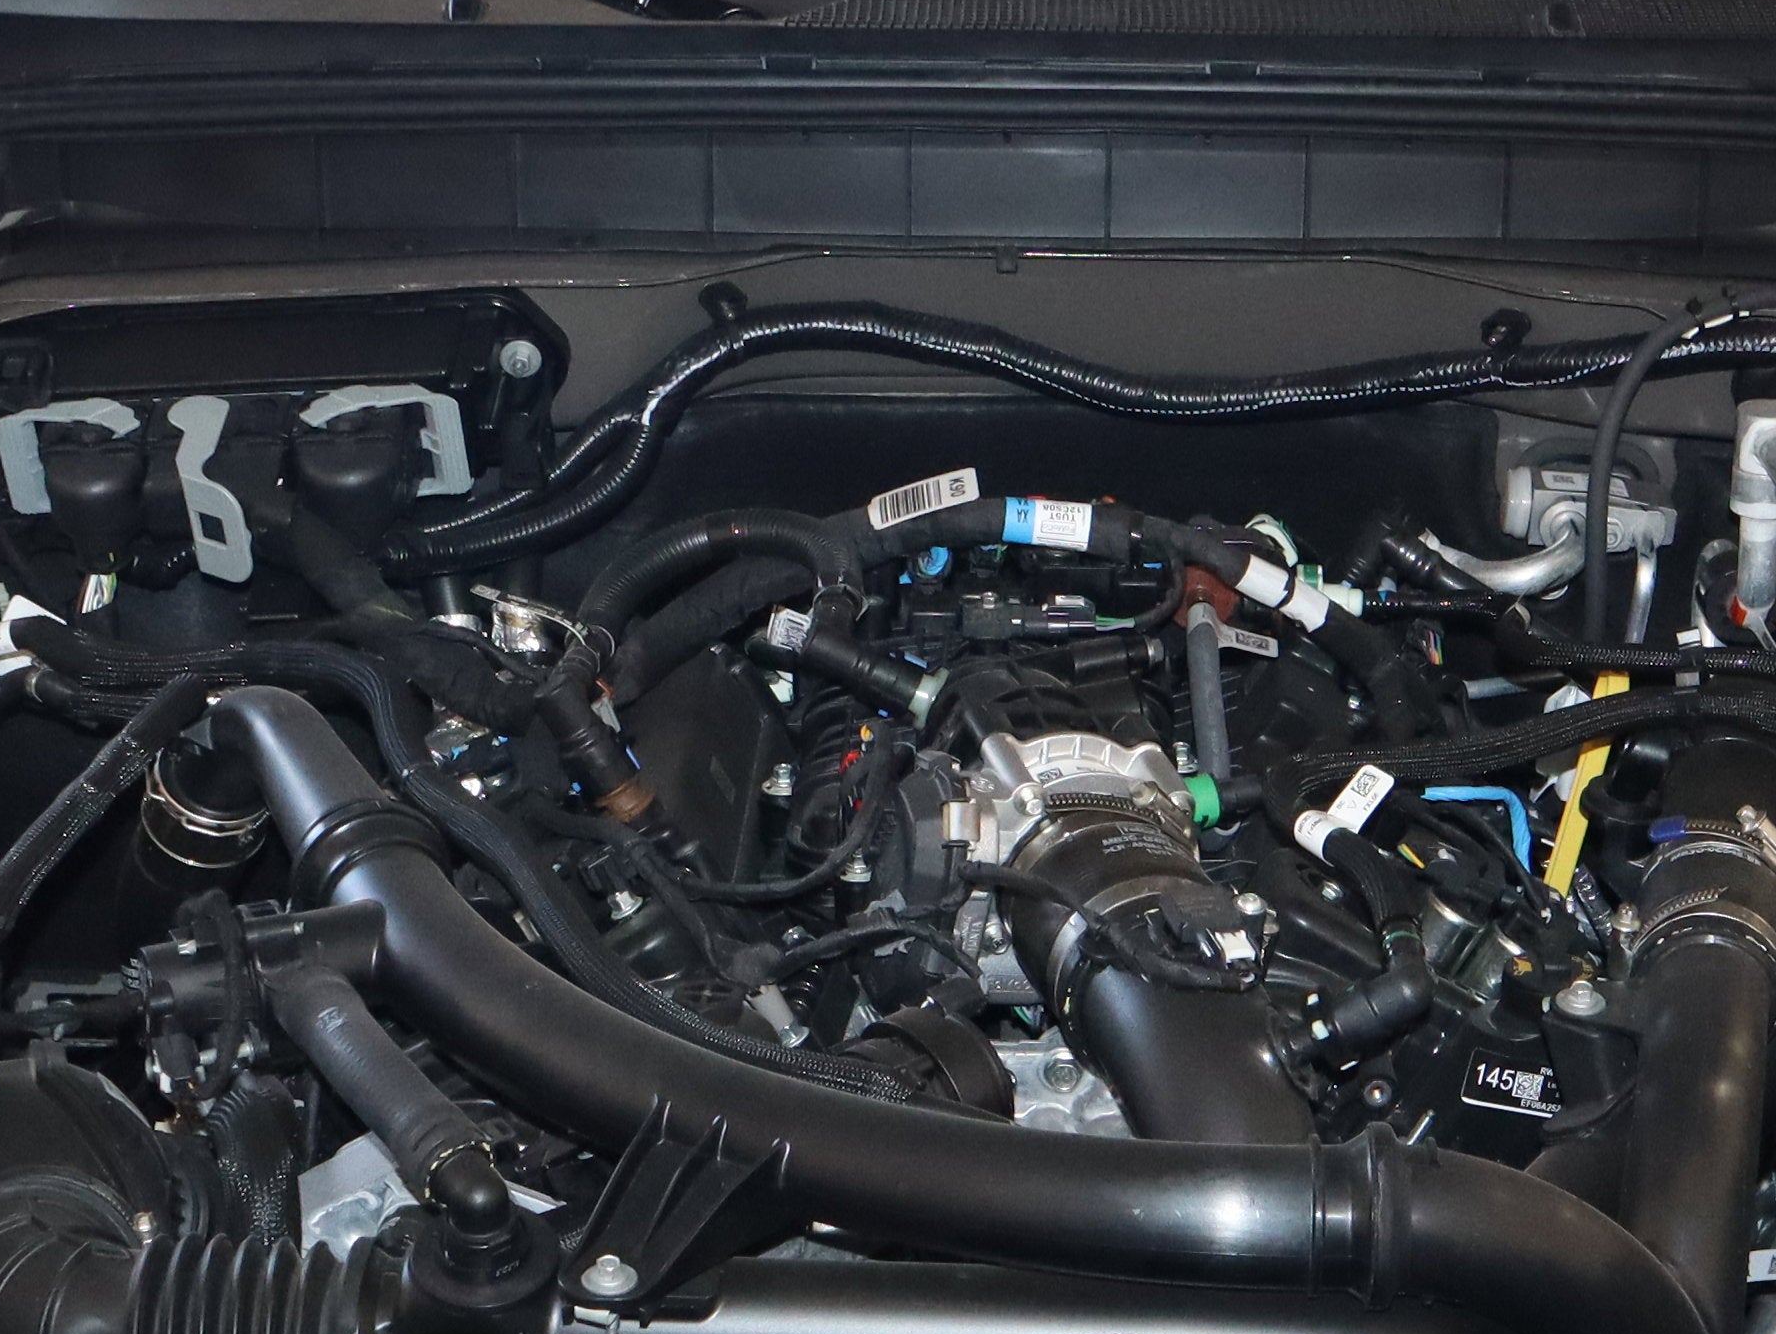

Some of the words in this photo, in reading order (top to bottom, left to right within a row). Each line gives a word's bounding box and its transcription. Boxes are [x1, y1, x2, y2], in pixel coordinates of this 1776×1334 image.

[949, 475, 967, 498] K90
[1016, 508, 1030, 524] XA
[1476, 1063, 1516, 1091] 145
